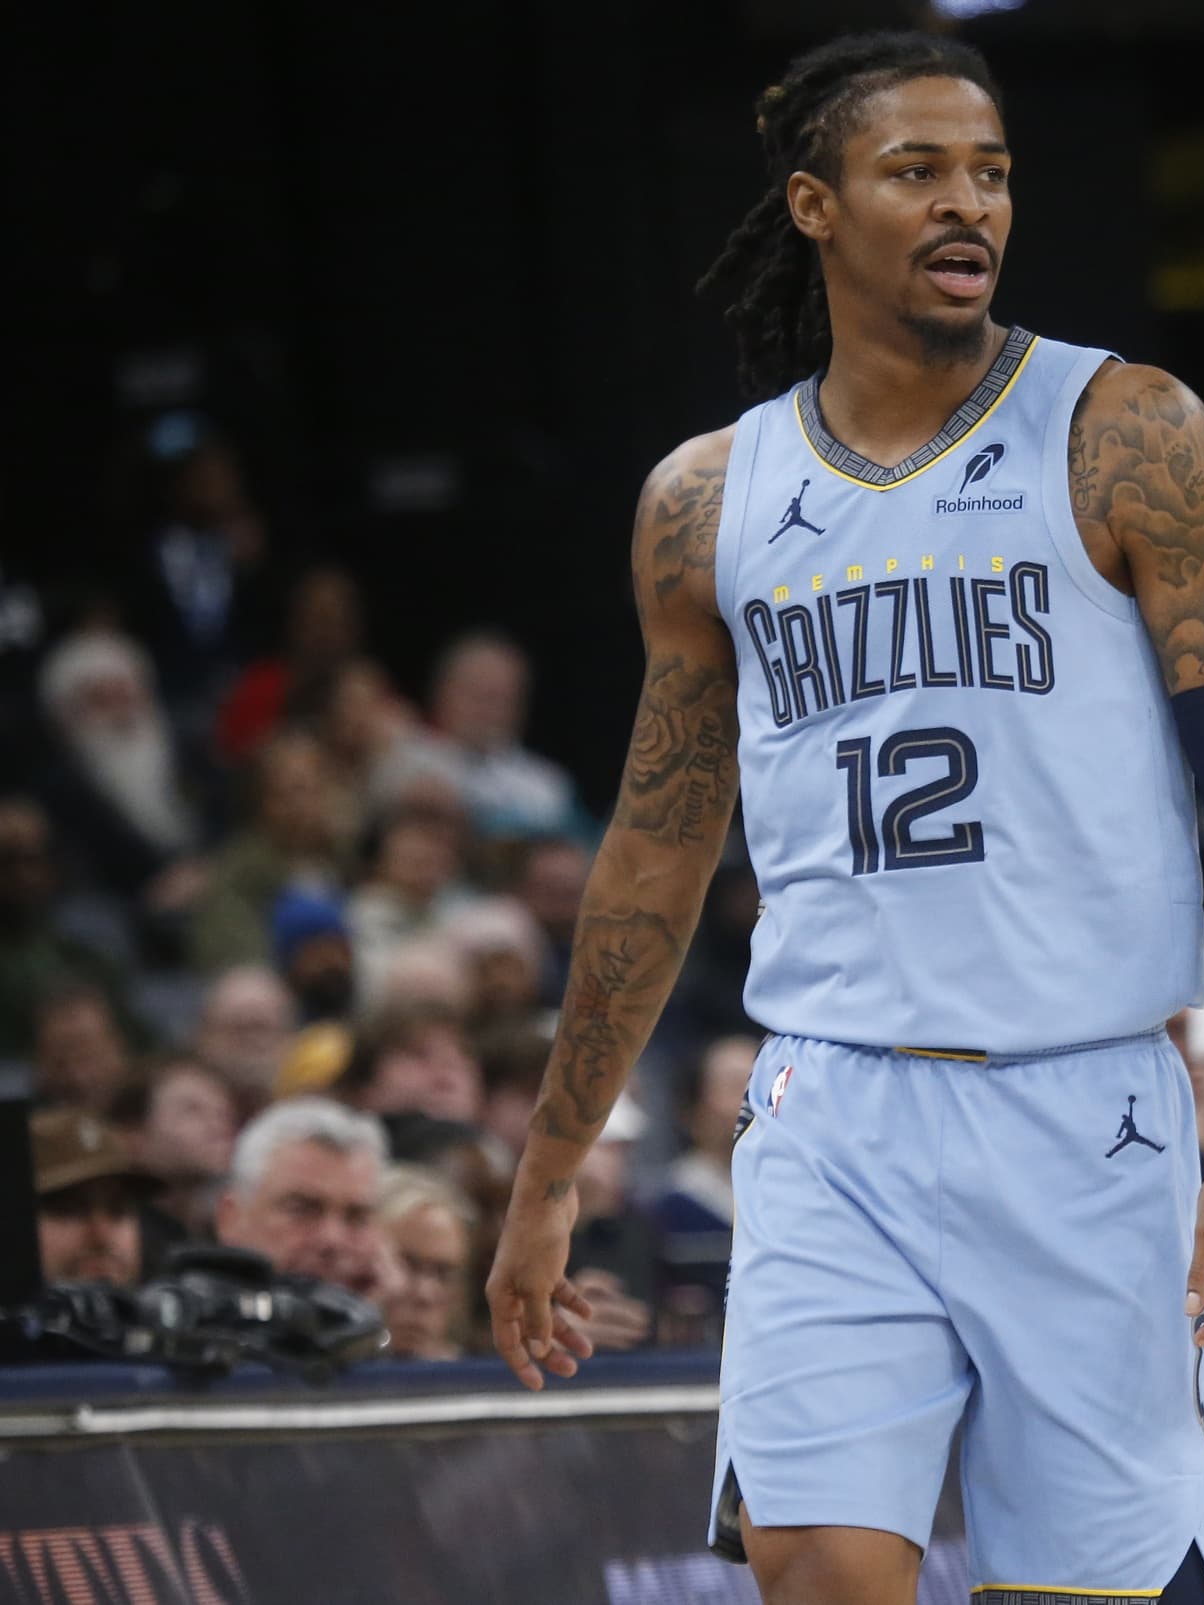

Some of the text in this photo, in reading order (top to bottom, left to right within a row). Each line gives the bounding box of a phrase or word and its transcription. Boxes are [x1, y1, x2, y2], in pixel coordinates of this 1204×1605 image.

[935, 494, 1023, 514] Robinhood
[773, 554, 1004, 604] MEMPHIS
[743, 561, 1055, 729] GRIZZLIES
[836, 726, 985, 877] 12
